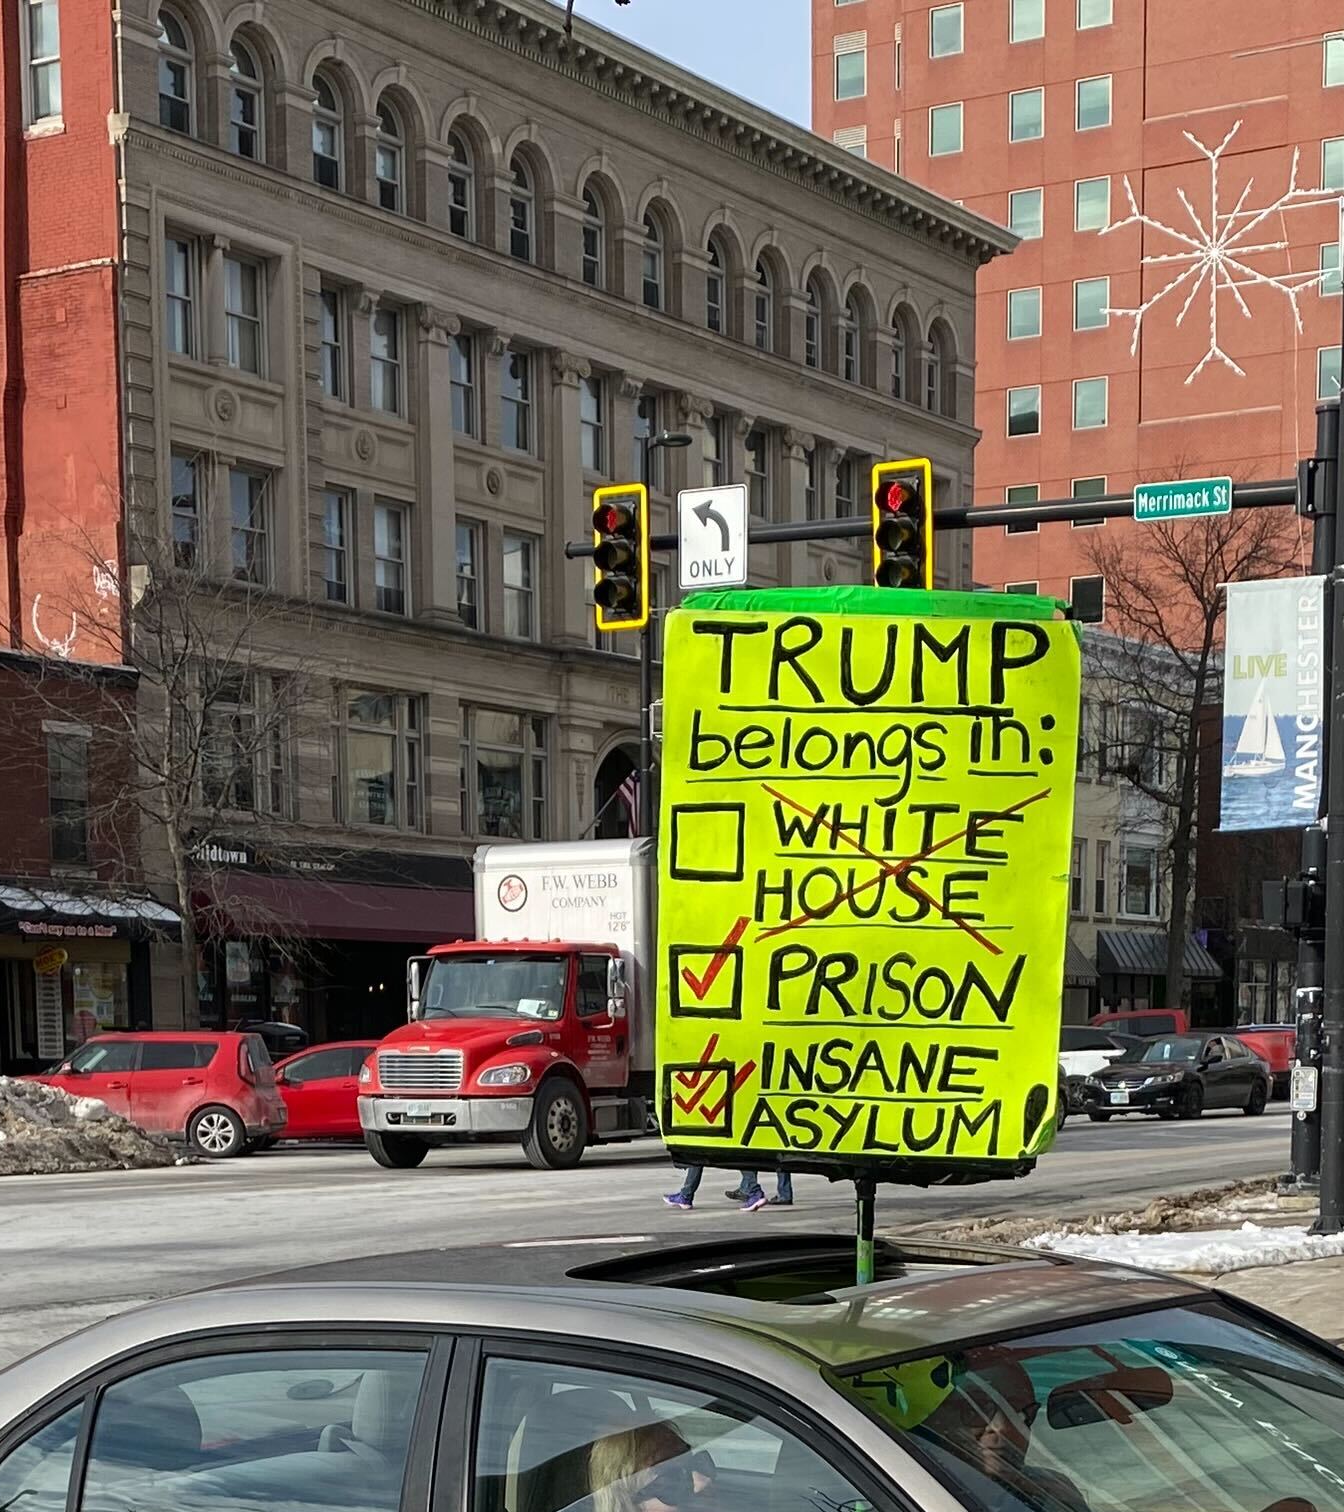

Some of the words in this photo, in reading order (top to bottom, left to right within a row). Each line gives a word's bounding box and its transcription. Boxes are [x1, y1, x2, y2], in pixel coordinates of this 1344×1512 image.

[1138, 486, 1210, 513] Merrimack
[1213, 485, 1228, 508] St
[689, 556, 736, 579] ONLY
[692, 615, 1051, 706] TRUMP
[1232, 652, 1288, 681] LIVE
[1291, 584, 1322, 810] MANCHESTER
[689, 708, 947, 807] belongs
[967, 713, 1057, 766] in:
[774, 800, 1024, 860] WHITE
[551, 895, 607, 909] COMPANY
[572, 873, 618, 889] WEBB
[755, 868, 990, 923] HOUSE
[766, 944, 1027, 1022] PRISON
[757, 1039, 999, 1095] INSANE
